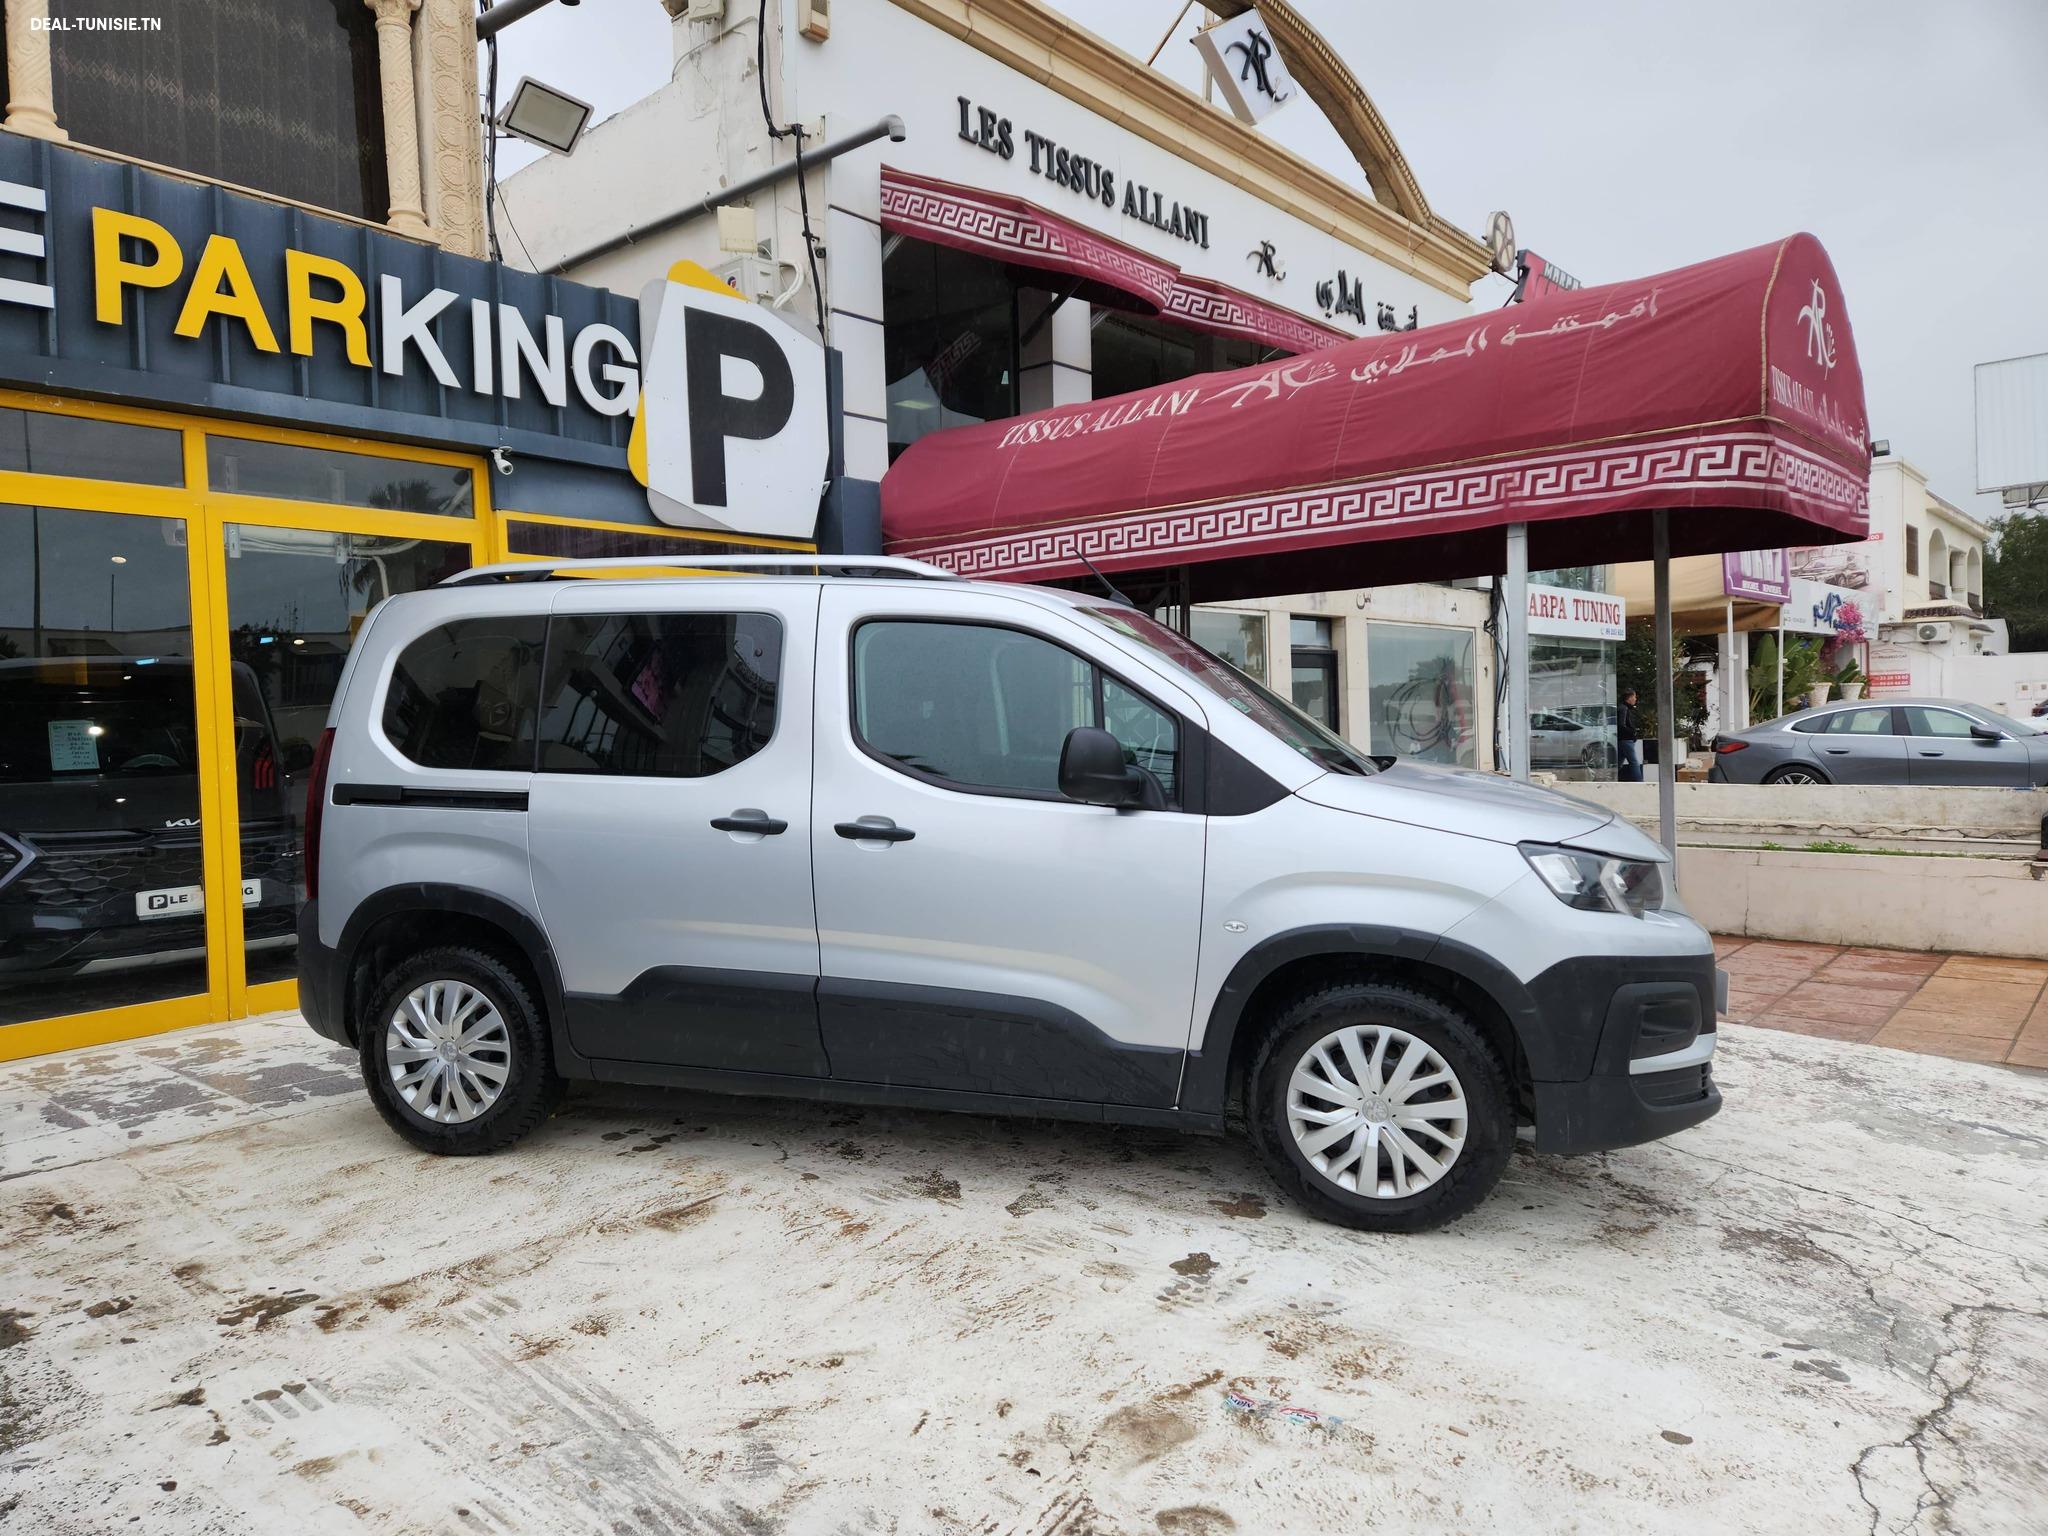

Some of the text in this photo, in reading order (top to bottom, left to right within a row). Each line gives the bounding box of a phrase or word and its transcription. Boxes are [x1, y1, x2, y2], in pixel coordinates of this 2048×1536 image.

[957, 95, 1209, 249] LES TISSUS ALLANI
[92, 206, 640, 418] PARKING
[684, 306, 795, 507] P
[997, 387, 1201, 449] TISSUS ALLANI
[1528, 593, 1621, 626] ARPA TUNING
[169, 894, 188, 905] LE
